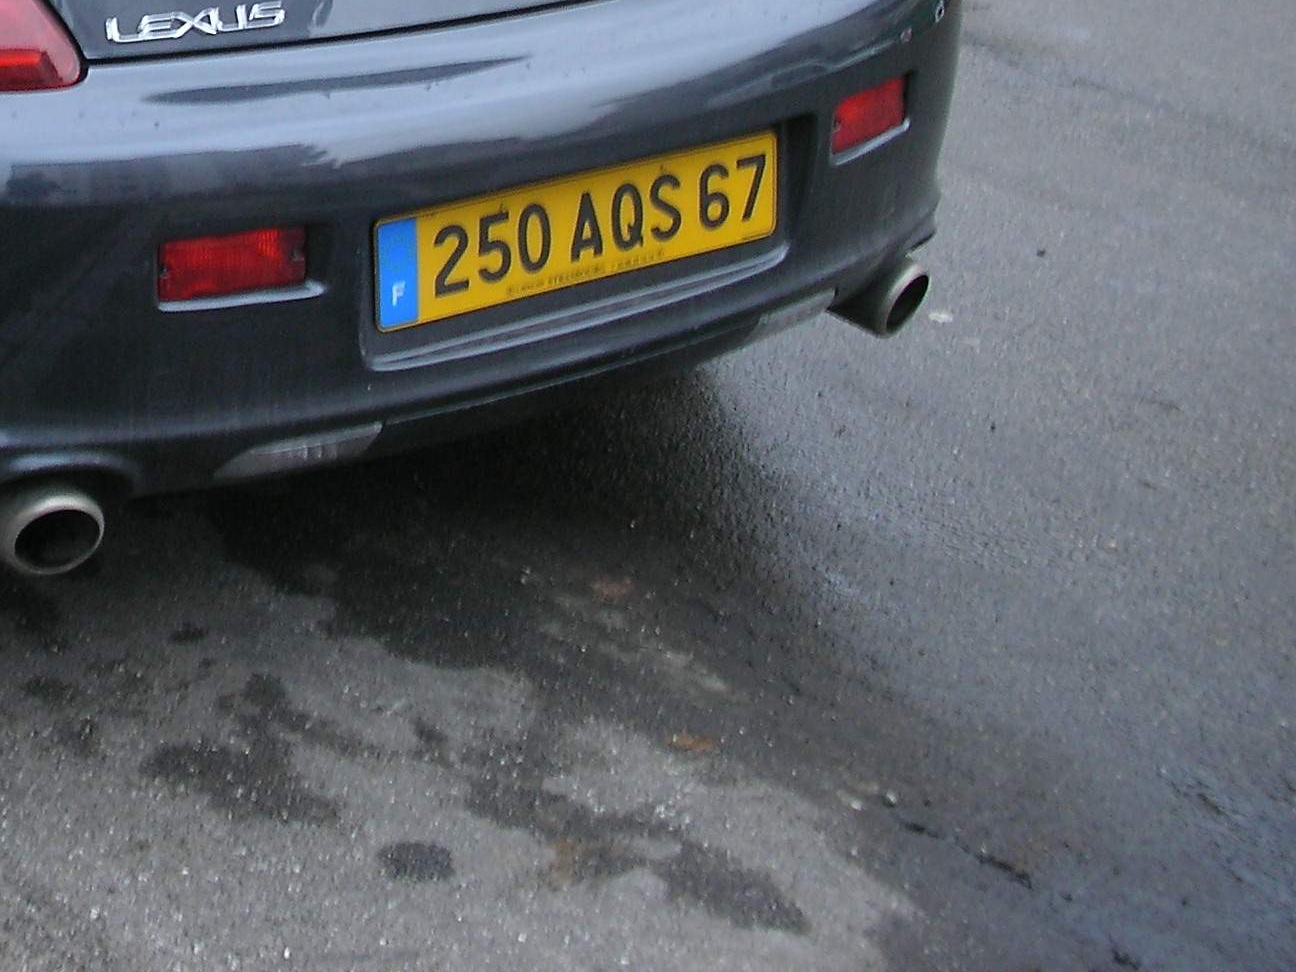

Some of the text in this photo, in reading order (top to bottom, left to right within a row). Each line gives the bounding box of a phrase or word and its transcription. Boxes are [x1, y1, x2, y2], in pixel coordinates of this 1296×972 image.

[105, 0, 286, 44] LEXUS
[432, 202, 552, 299] 250
[569, 173, 683, 263] AQS
[698, 153, 767, 230] 67
[390, 281, 406, 307] F
